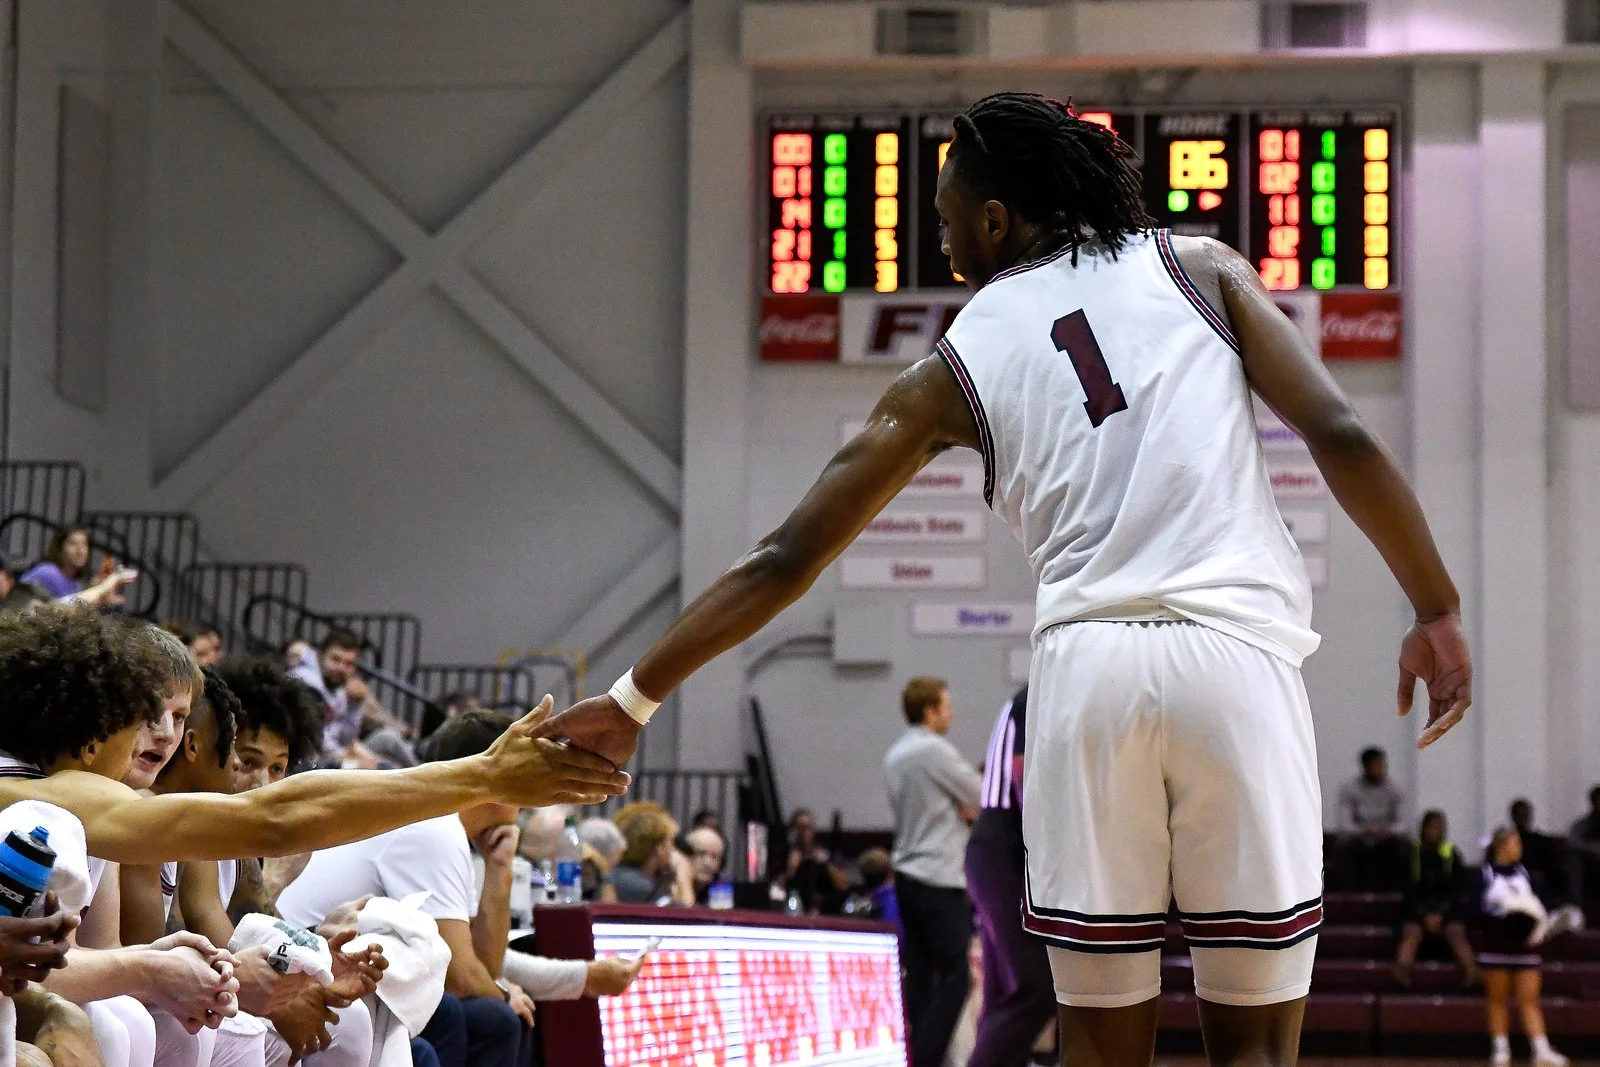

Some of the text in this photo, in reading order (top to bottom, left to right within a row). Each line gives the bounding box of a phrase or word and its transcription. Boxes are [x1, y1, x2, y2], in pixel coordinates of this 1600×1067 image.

[1321, 130, 1335, 160] 1
[1169, 140, 1228, 189] 86
[772, 229, 811, 261] 21
[833, 229, 847, 259] 1
[1321, 226, 1335, 256] 1
[1050, 308, 1128, 428] 1
